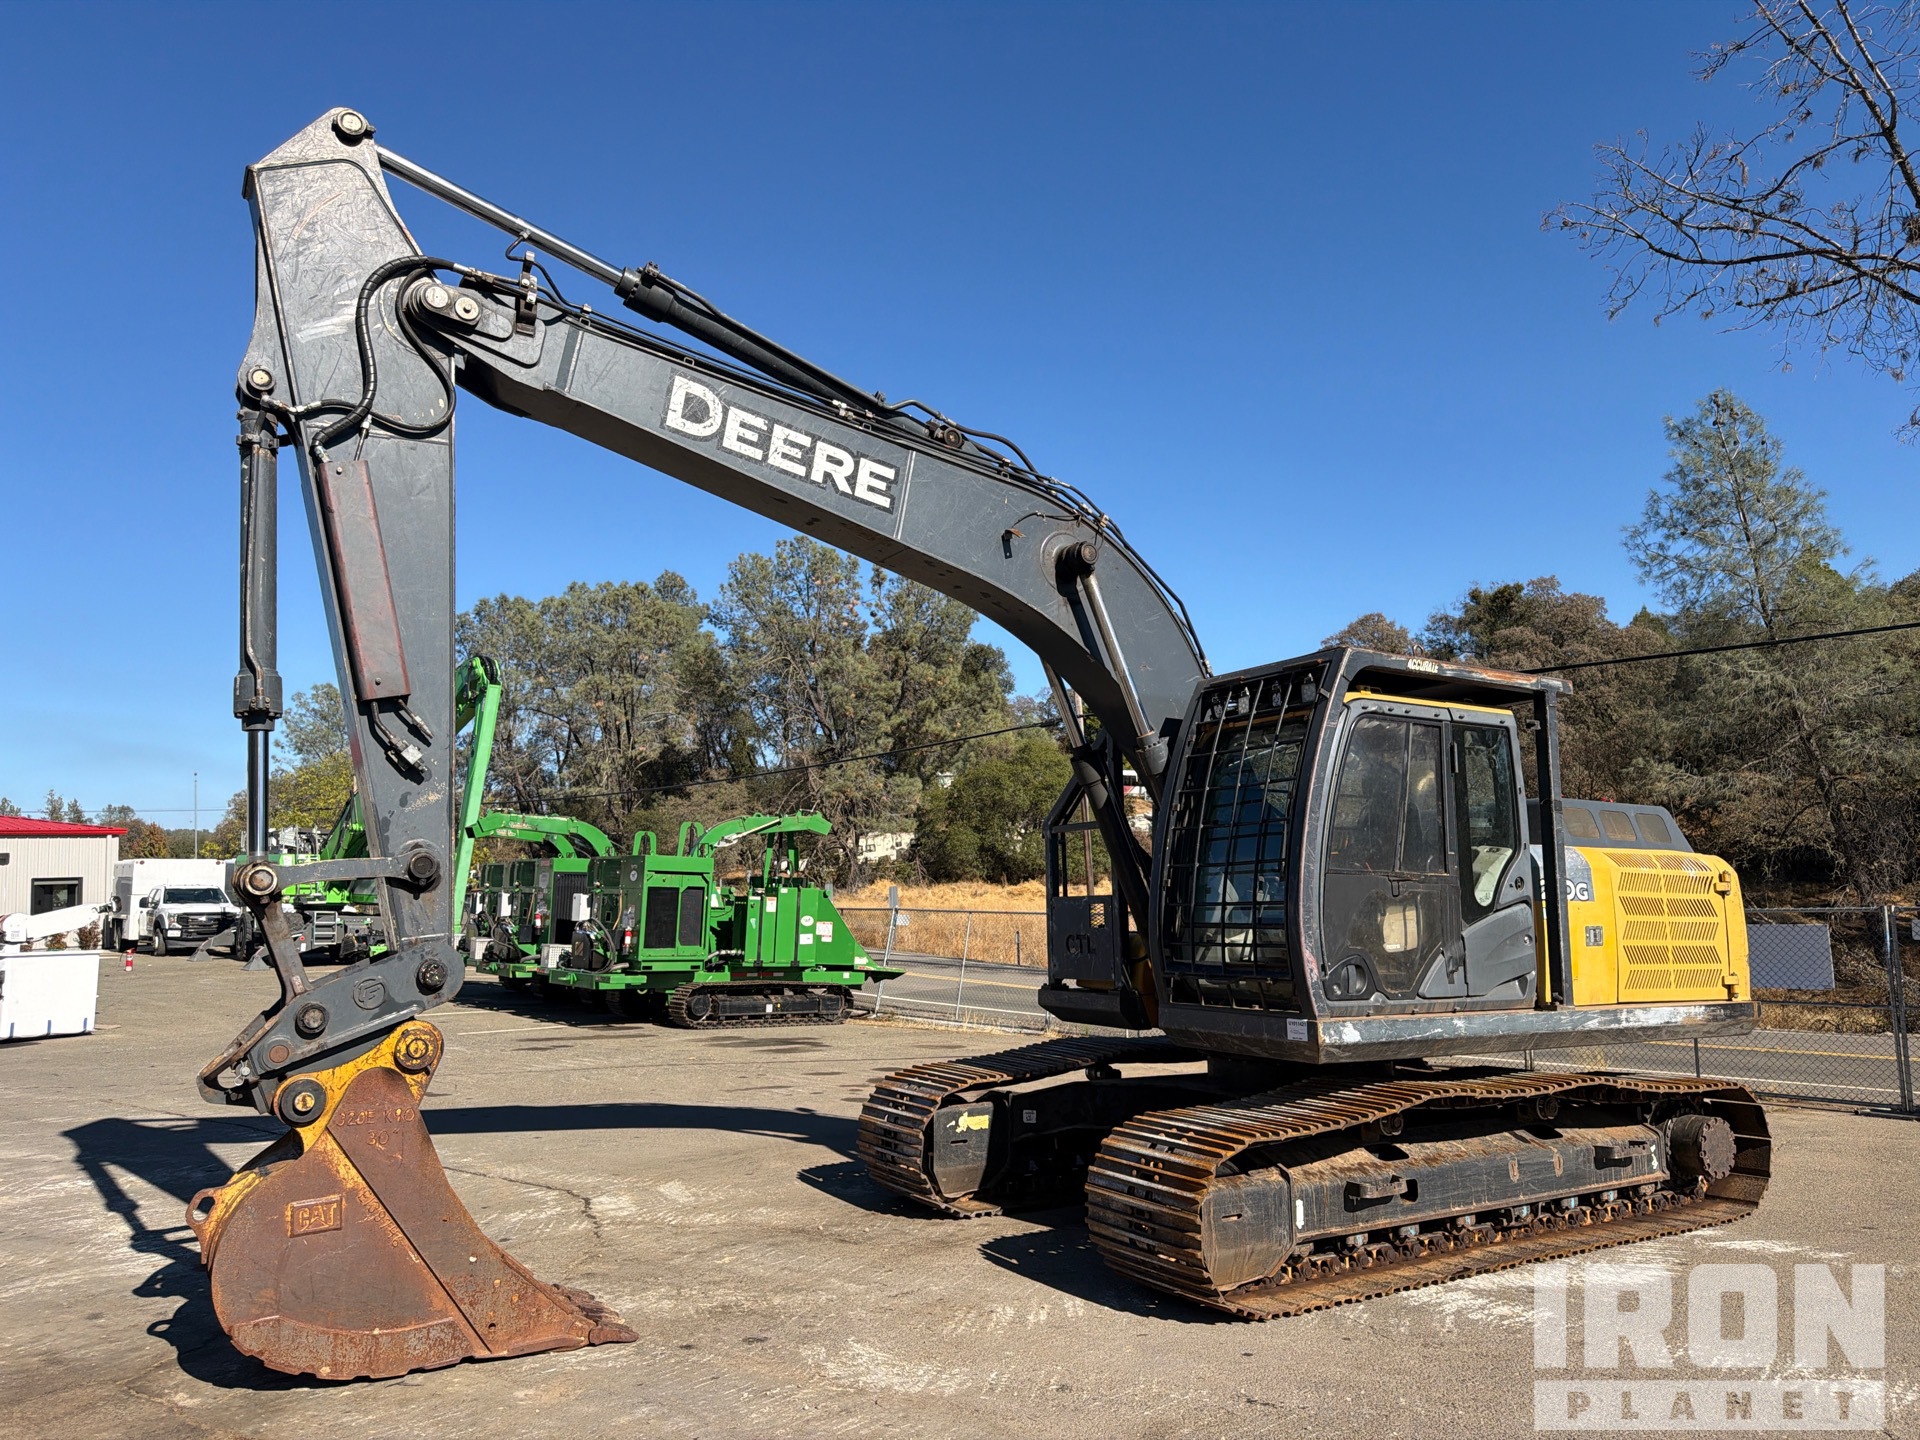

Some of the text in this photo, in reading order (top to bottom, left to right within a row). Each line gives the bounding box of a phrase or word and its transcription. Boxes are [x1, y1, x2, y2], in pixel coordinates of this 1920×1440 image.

[665, 374, 896, 509] DEERE
[1065, 933, 1097, 955] CTL
[299, 1202, 338, 1232] CAT
